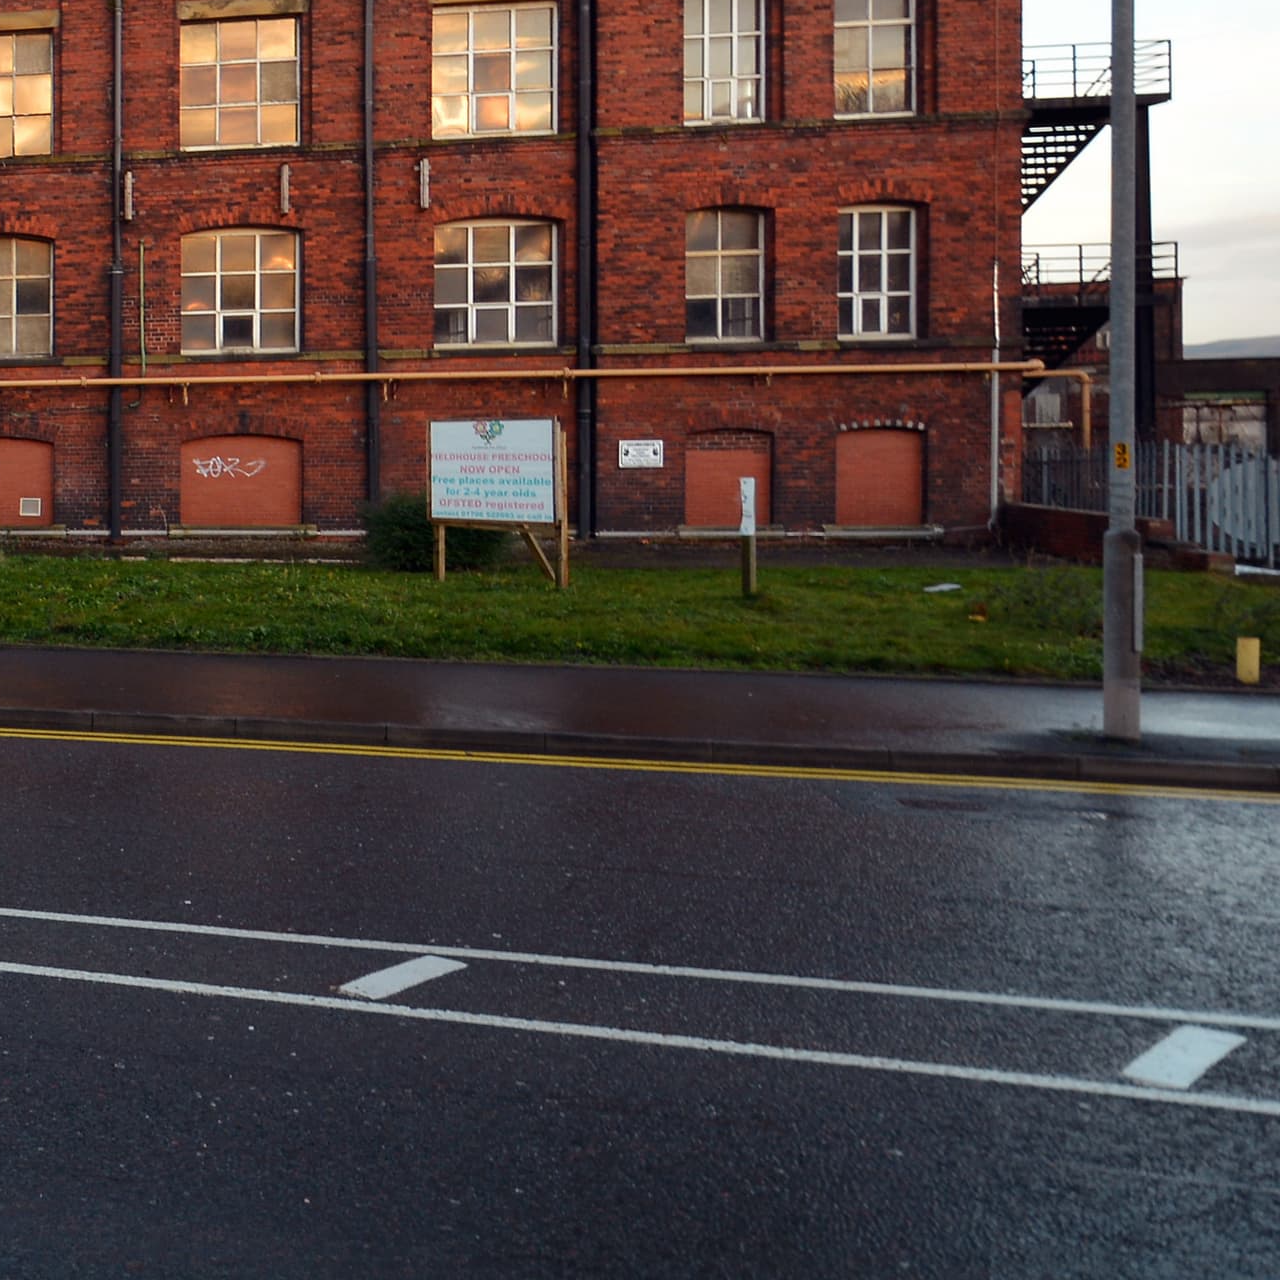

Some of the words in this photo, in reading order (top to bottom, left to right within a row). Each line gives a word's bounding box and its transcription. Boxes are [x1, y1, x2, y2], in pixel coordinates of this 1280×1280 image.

[432, 452, 488, 461] IELDHOUSE
[460, 465, 486, 473] NOW
[489, 465, 520, 473] OPEN
[432, 476, 455, 485] Free
[459, 476, 495, 486] places
[499, 476, 552, 486] available
[446, 487, 460, 496] for
[463, 487, 481, 496] 2-4
[484, 489, 508, 498] year
[512, 488, 537, 497] olds
[439, 499, 482, 507] OFSTED
[485, 500, 545, 510] registered
